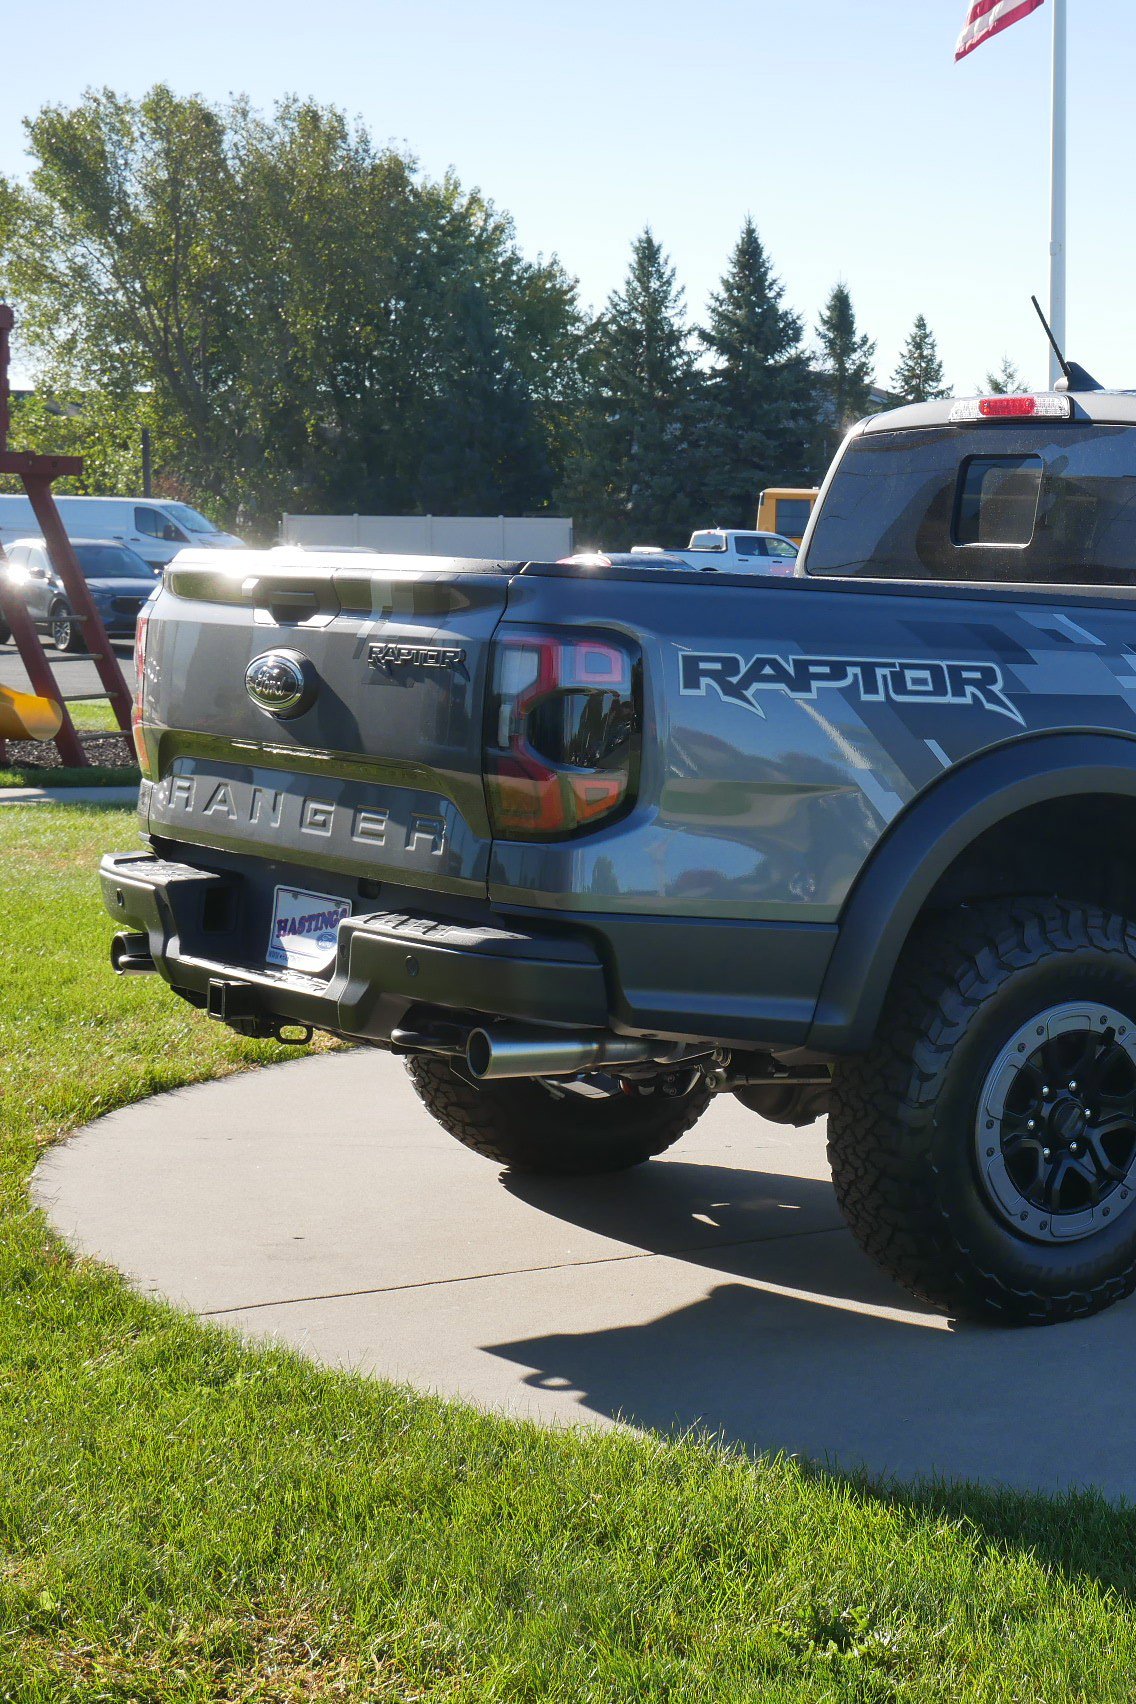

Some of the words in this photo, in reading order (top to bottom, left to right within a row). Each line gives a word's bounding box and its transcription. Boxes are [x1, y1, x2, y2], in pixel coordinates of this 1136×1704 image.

[368, 642, 469, 677] RAPTOR
[678, 651, 1027, 728] RAPTOR
[168, 774, 449, 856] RANGER
